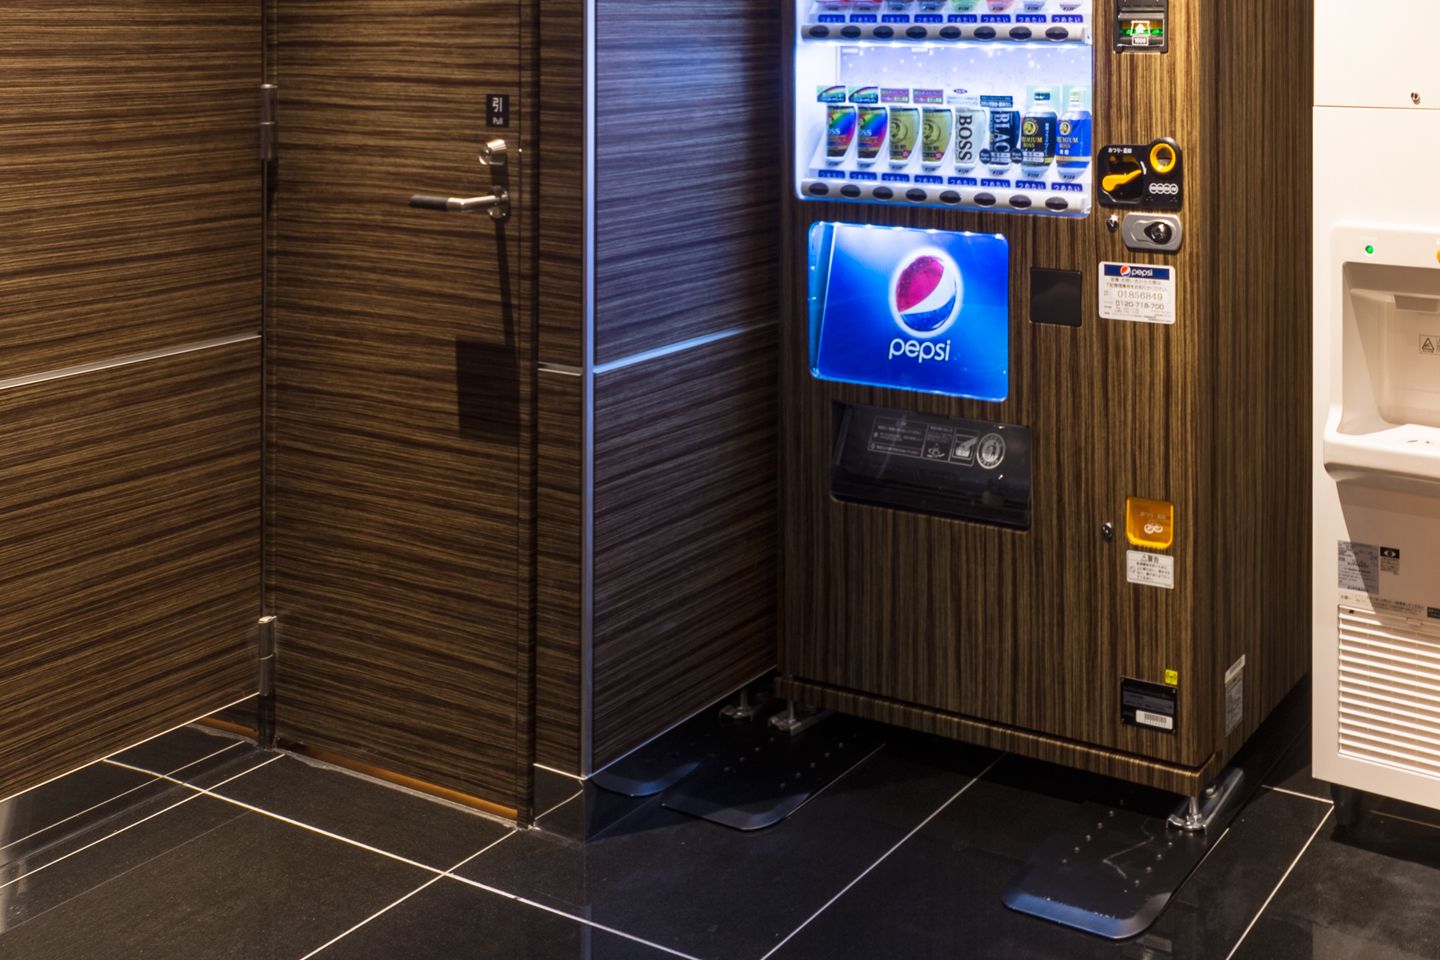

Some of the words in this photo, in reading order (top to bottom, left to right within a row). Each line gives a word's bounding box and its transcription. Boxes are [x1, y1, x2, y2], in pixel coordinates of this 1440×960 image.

[493, 97, 503, 113] 引
[493, 117, 503, 126] Pull
[958, 115, 973, 161] BOSS
[994, 113, 1011, 152] BLAC
[1131, 268, 1153, 277] pepsi
[888, 338, 951, 363] pepsi
